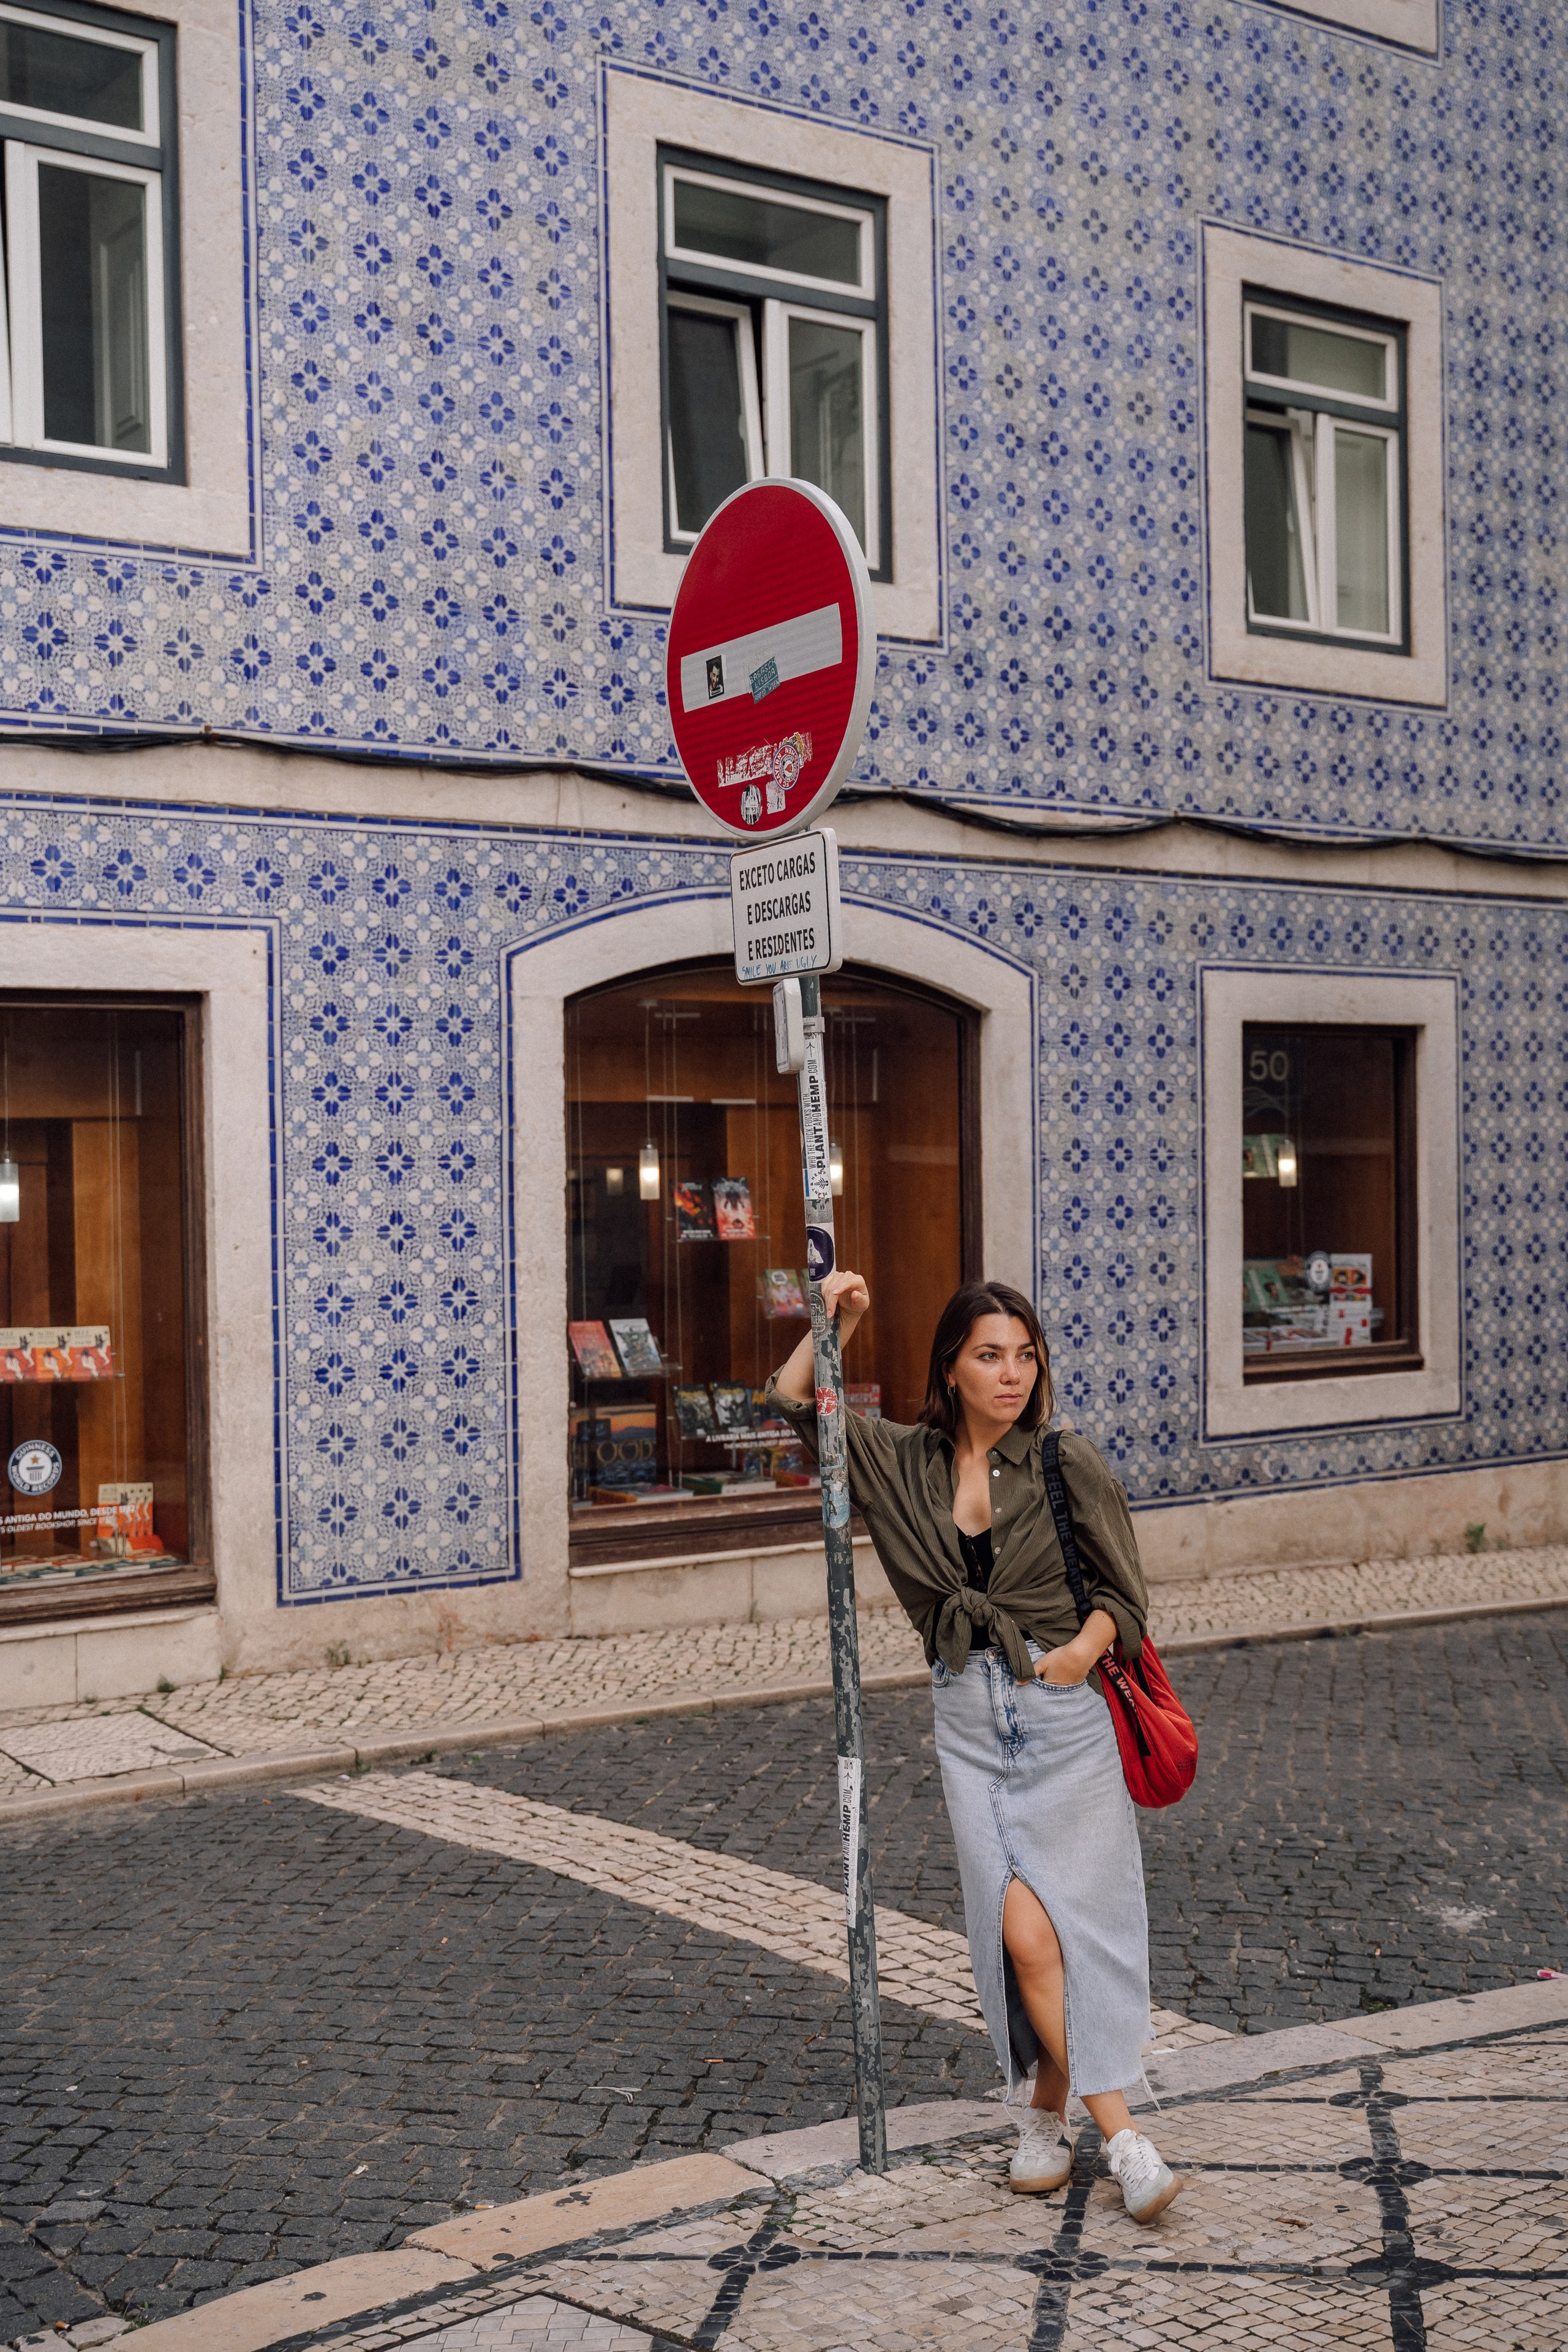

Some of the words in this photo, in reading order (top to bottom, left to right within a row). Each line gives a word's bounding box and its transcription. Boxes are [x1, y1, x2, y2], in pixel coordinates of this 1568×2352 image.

[755, 668, 775, 688] LISBOA
[754, 689, 767, 701] RAPID
[767, 678, 780, 691] WIEN
[739, 862, 774, 891] EXCETO
[777, 852, 815, 881] CARGAS
[747, 904, 753, 925] E
[755, 891, 811, 923] DESCARGAS
[748, 940, 753, 961] E
[756, 927, 815, 960] RESIDENTES
[742, 964, 761, 979] SMILE
[766, 962, 777, 976] YOU
[780, 959, 793, 973] ARE
[796, 954, 817, 969] UGLY
[1250, 1050, 1289, 1081] 50
[804, 1109, 813, 1127] FUCKS
[805, 1128, 814, 1143] FUCK
[807, 1144, 815, 1155] THE
[15, 1442, 56, 1461] GUINNESS
[12, 1465, 31, 1491] WORLD
[31, 1461, 60, 1492] RECORDS
[4, 1513, 37, 1525] ANTIGA
[38, 1512, 52, 1522] DO
[90, 1506, 117, 1517] DESDE
[6, 1523, 35, 1533] OLDEST
[77, 1517, 97, 1527] SINCE
